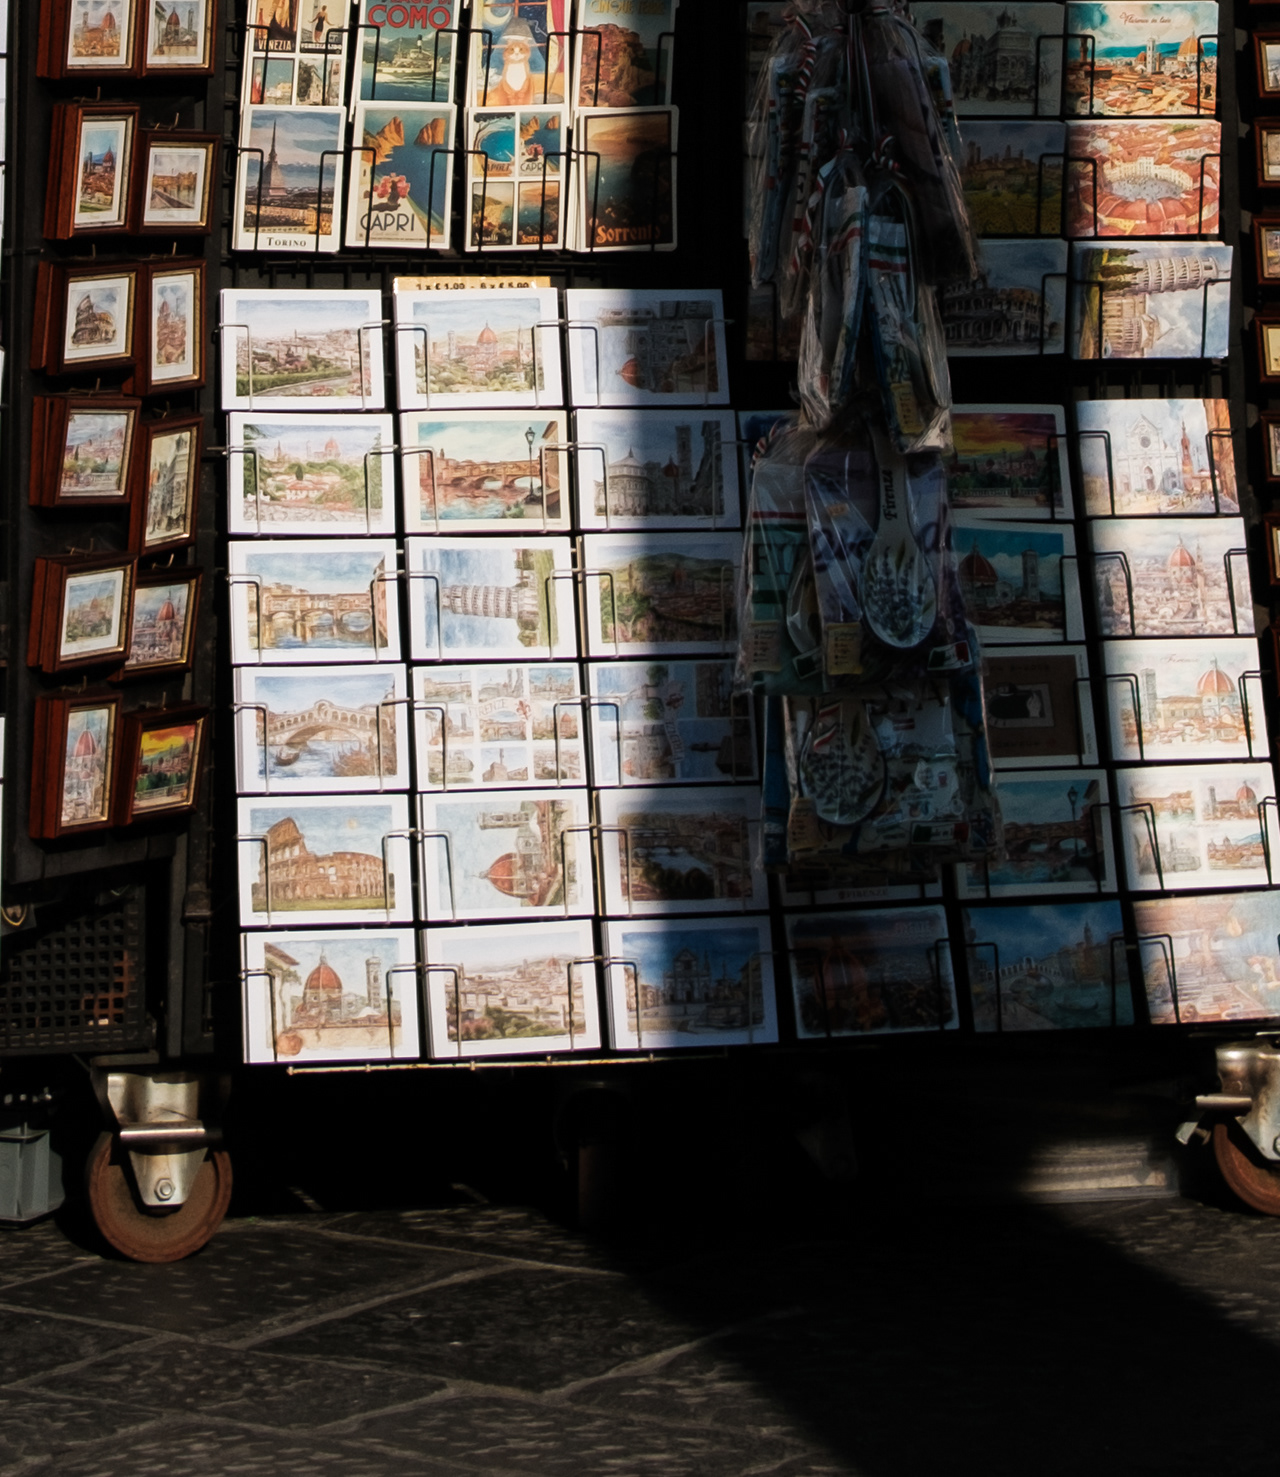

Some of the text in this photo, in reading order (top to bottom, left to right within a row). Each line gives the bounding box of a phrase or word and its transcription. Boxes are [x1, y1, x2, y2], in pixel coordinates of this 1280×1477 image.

[367, 4, 452, 30] COMO
[520, 161, 546, 172] CAPR
[359, 212, 415, 231] CAPRI
[266, 236, 307, 247] TORINO
[881, 469, 898, 521] Firenze
